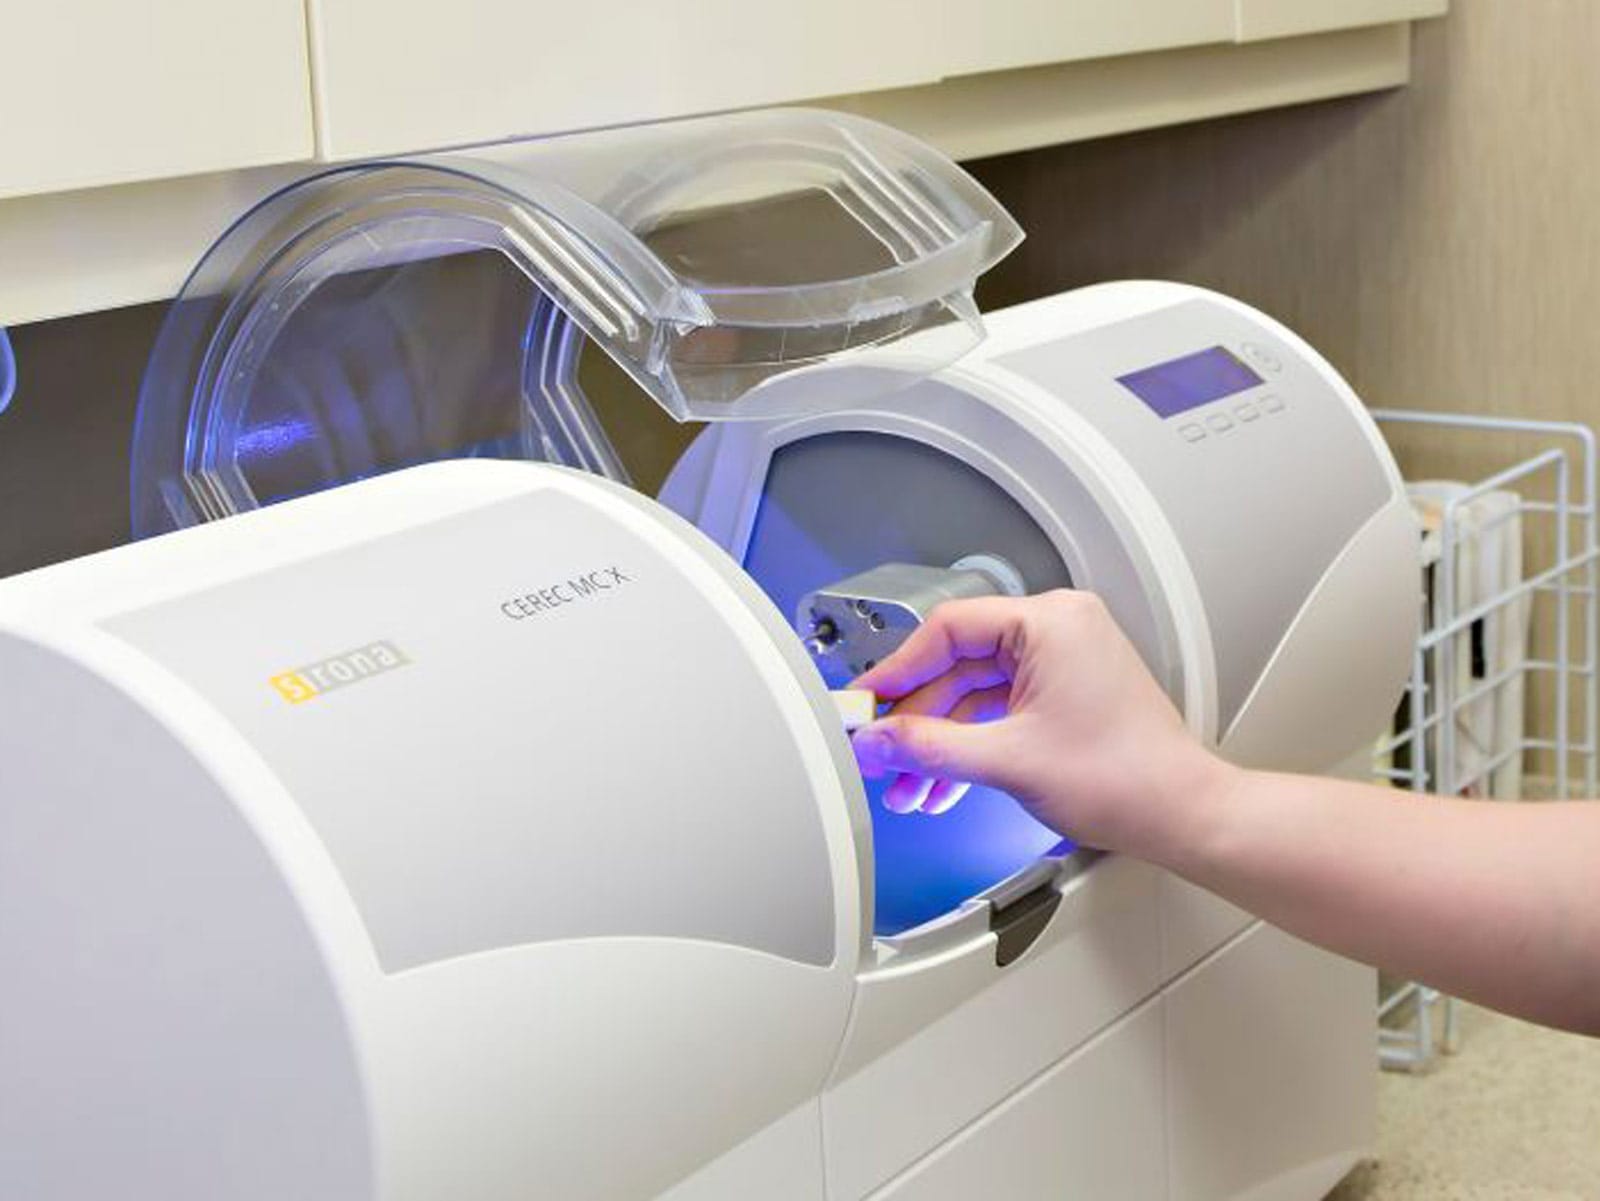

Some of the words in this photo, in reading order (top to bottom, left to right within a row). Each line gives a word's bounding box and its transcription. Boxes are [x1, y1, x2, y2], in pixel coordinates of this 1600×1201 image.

[500, 584, 574, 620] CEREC
[567, 571, 612, 598] MC
[603, 566, 632, 584] X
[275, 644, 401, 701] sirona
